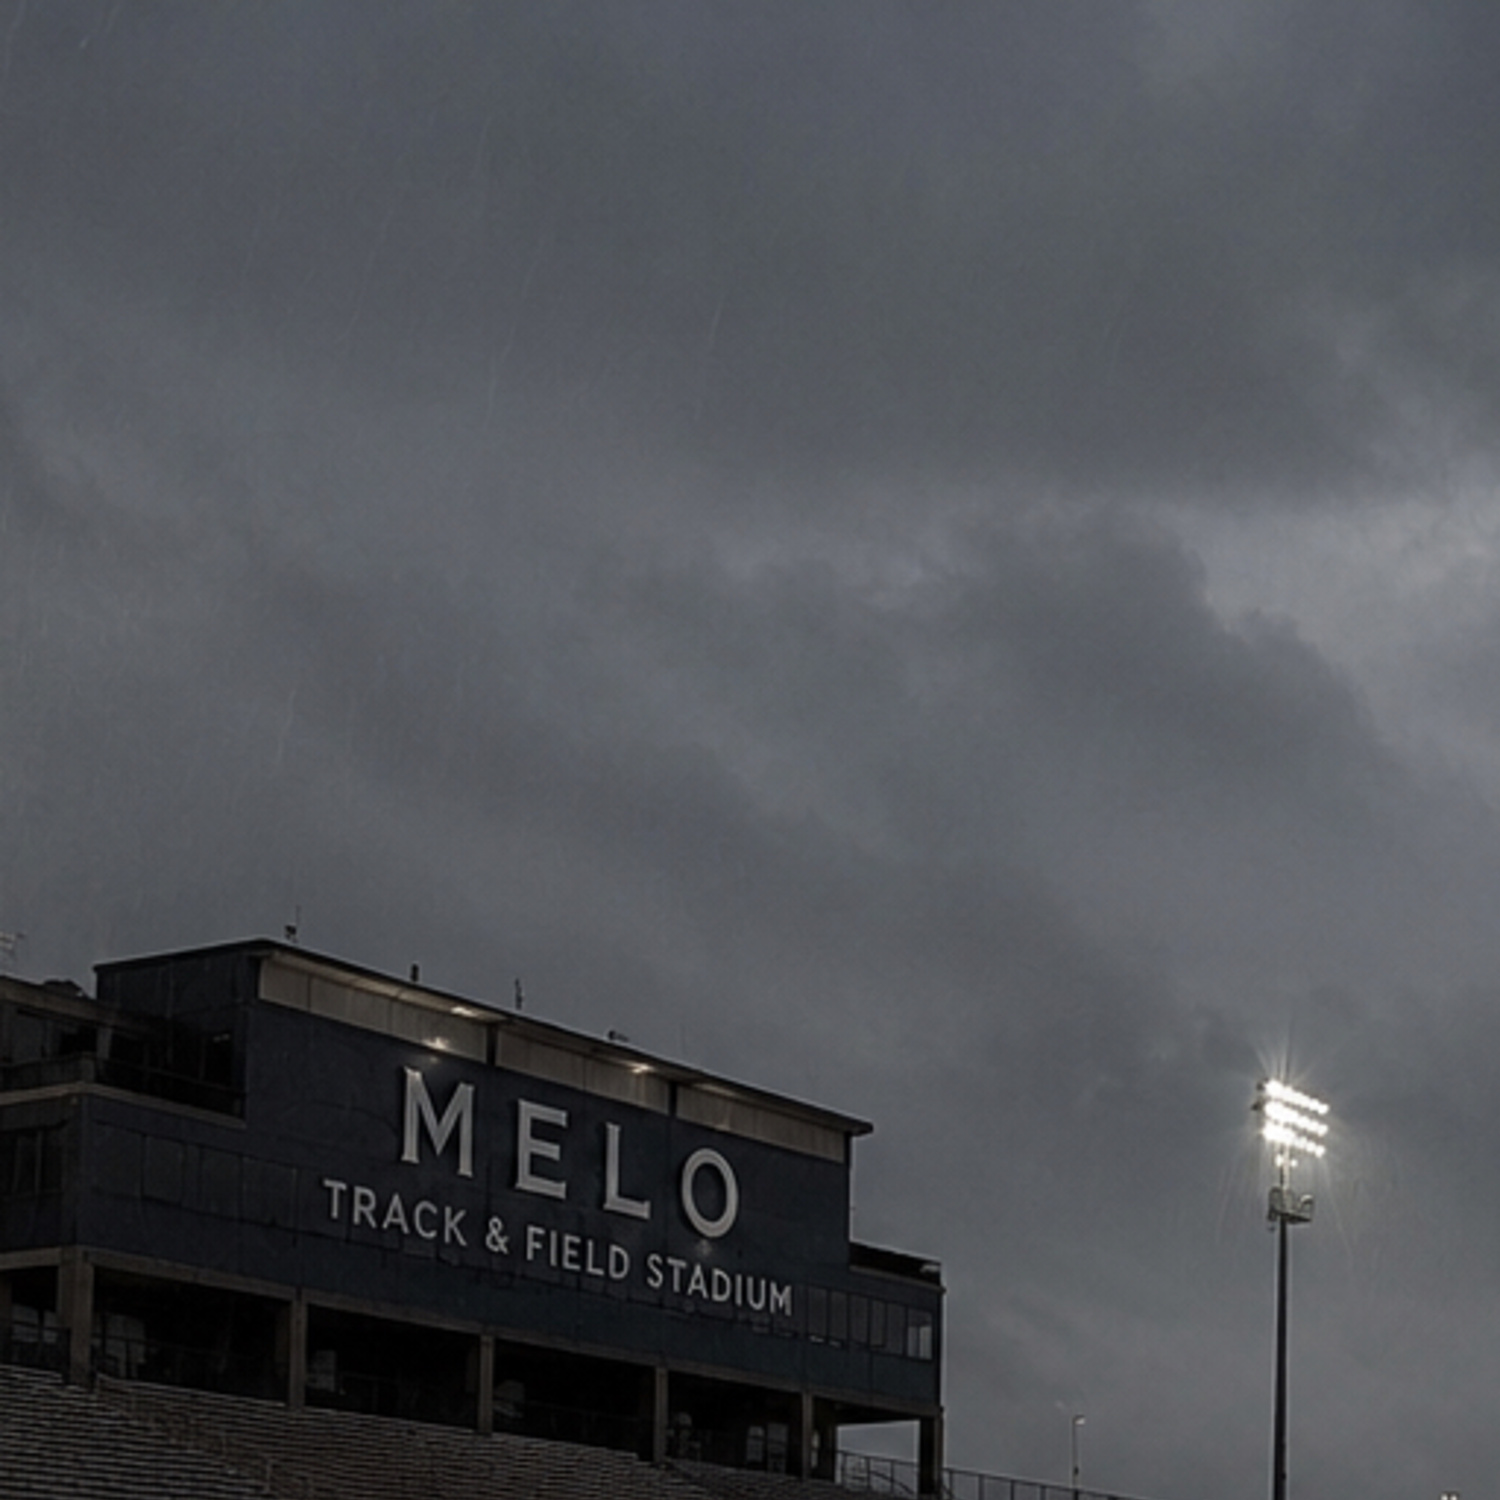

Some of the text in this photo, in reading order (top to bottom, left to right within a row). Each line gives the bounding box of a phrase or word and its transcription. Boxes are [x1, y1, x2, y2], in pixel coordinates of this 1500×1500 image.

[400, 1065, 740, 1240] MELO
[322, 1177, 794, 1317] TRACK & FIELD STADIUM
